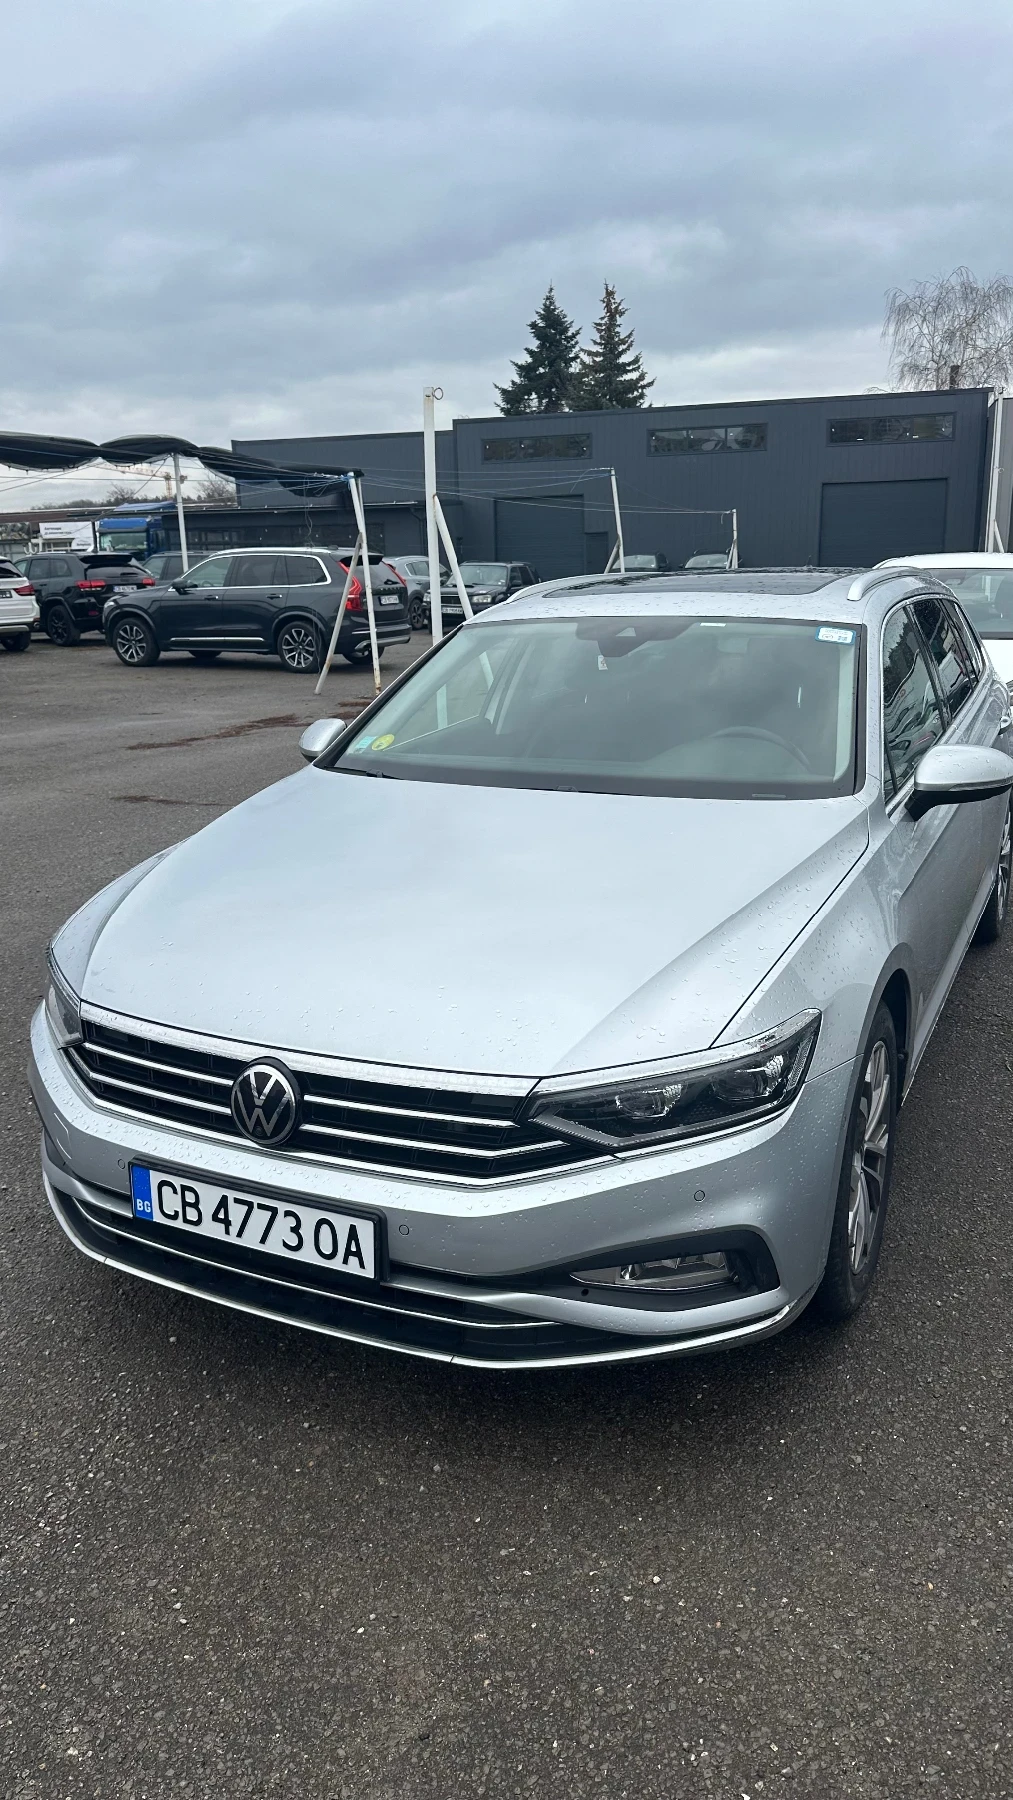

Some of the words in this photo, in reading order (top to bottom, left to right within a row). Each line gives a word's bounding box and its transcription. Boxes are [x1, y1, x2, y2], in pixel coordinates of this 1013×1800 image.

[234, 1067, 292, 1139] VW
[136, 1198, 152, 1214] BG
[156, 1178, 204, 1228] CB
[210, 1193, 305, 1253] 4773
